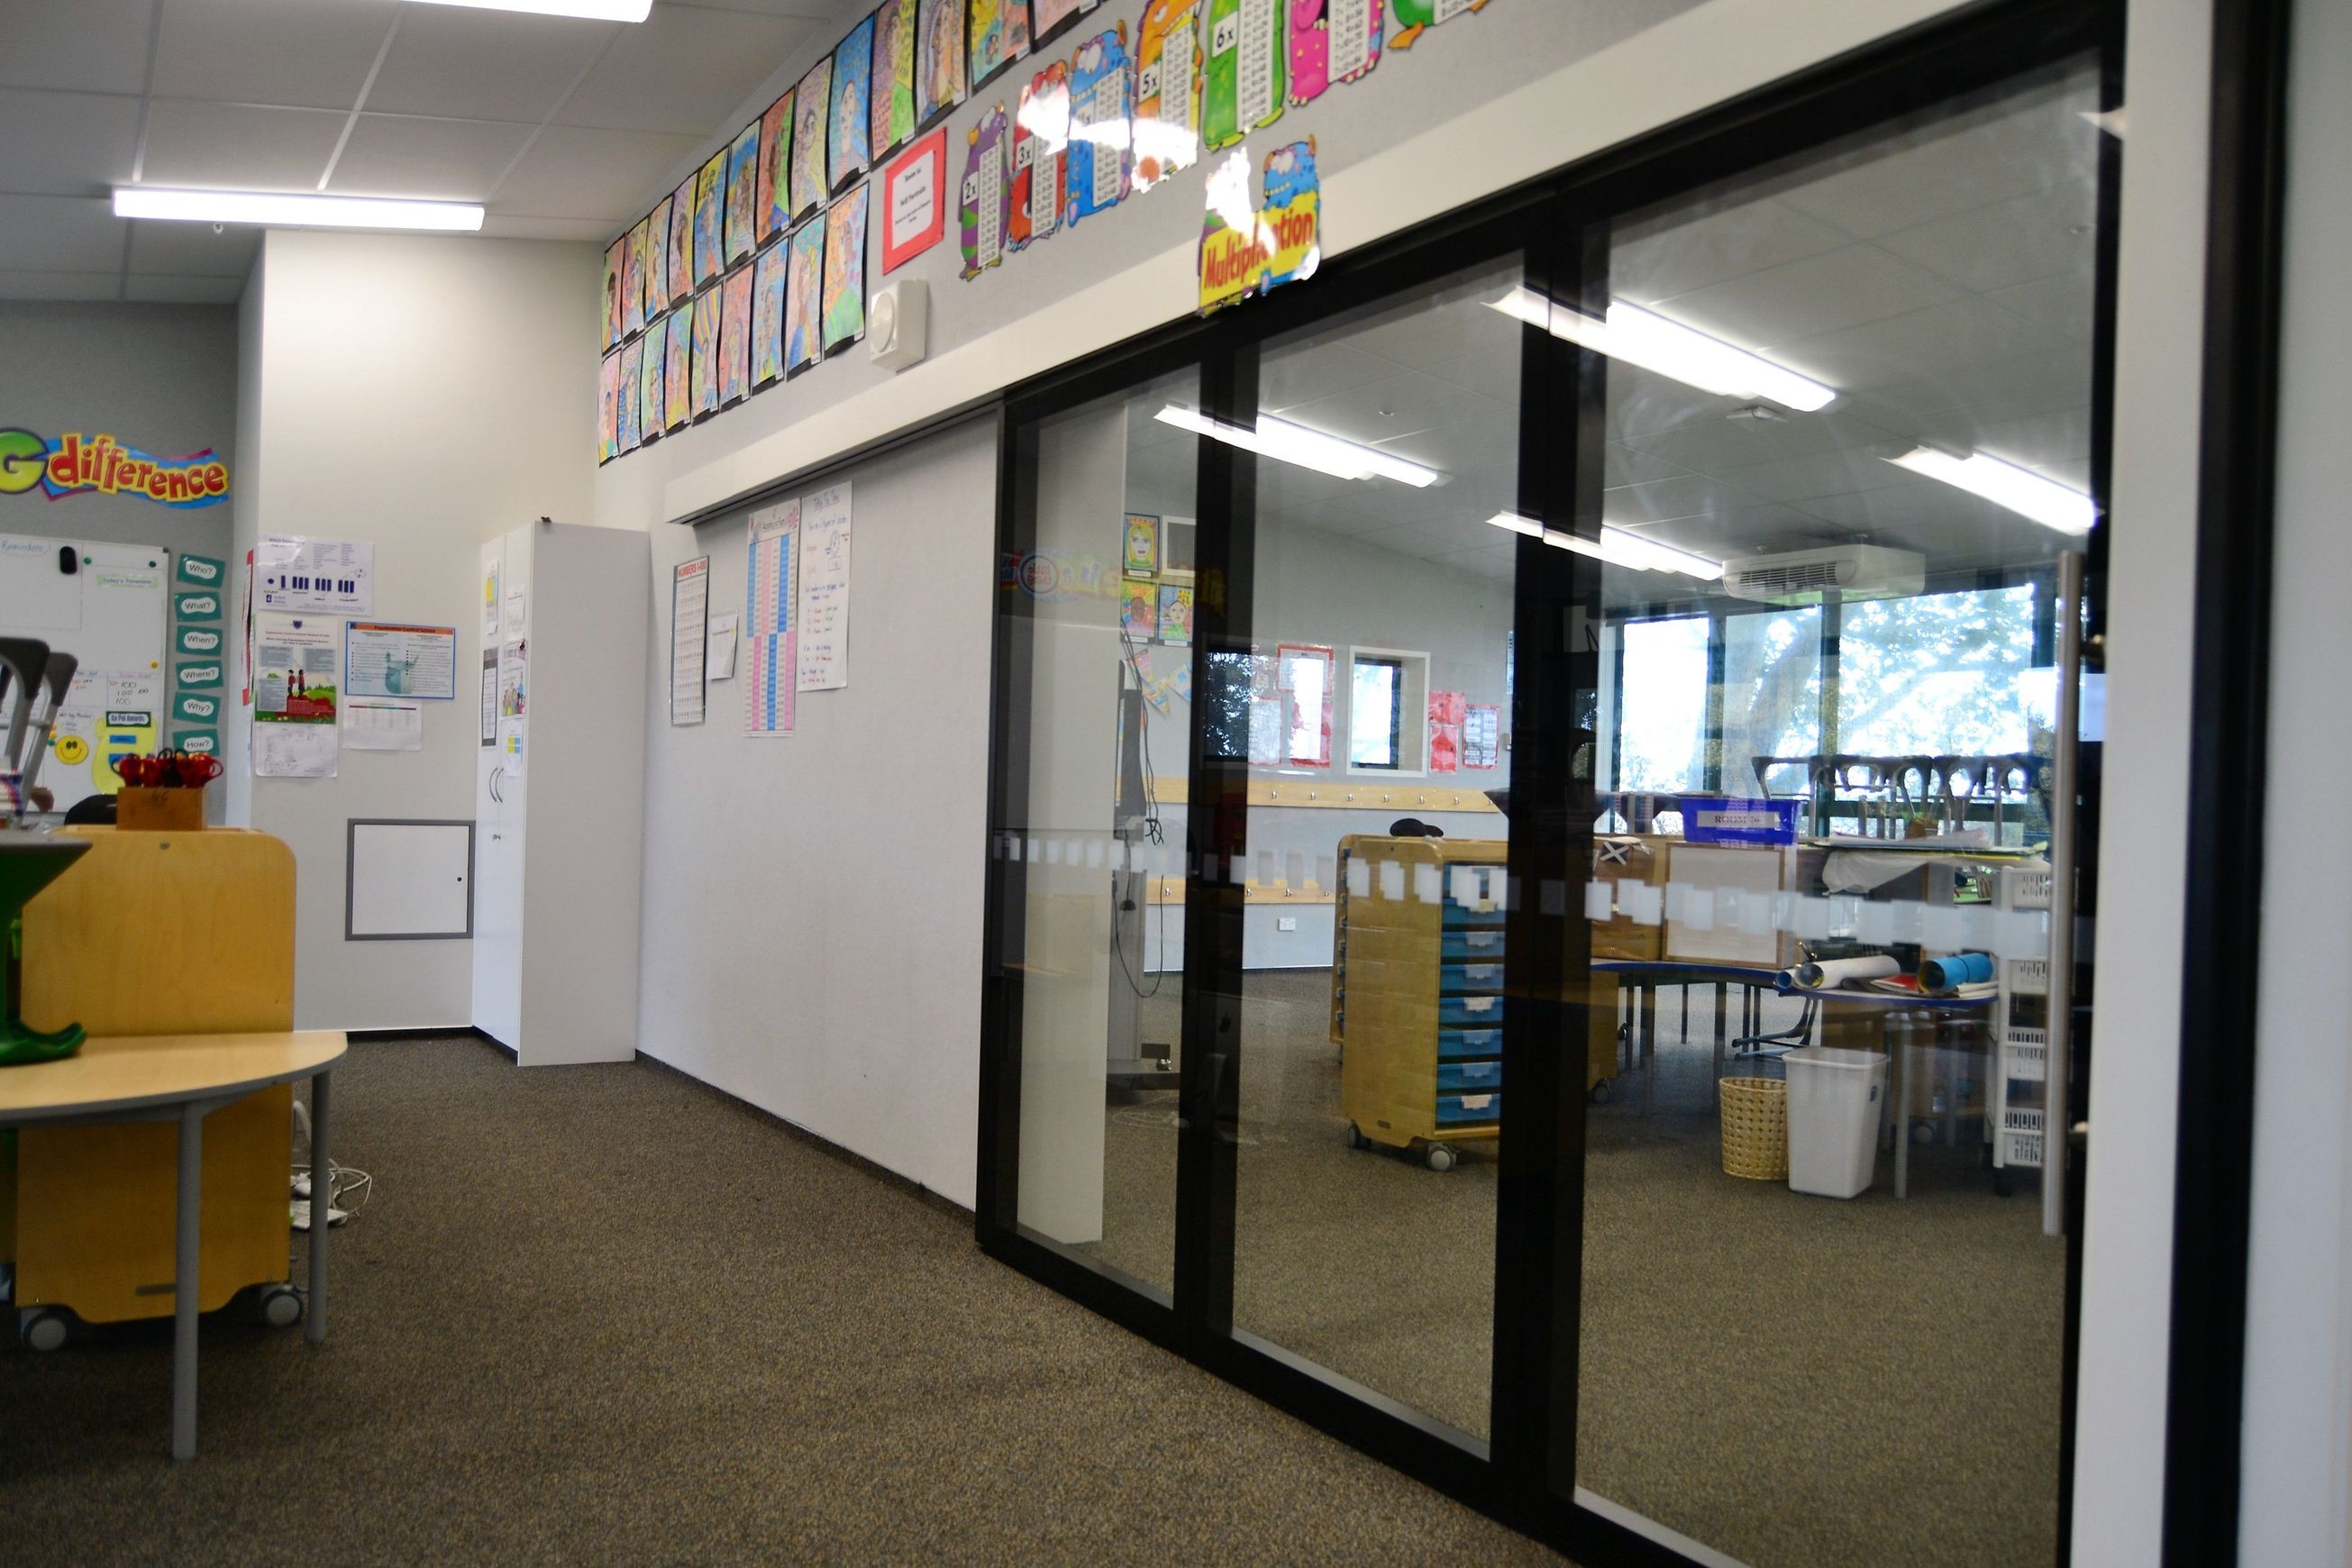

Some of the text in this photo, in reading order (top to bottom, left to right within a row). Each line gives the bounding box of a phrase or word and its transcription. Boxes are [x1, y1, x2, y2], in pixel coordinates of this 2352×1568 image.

[1217, 26, 1234, 49] 6x
[1143, 73, 1158, 95] 5x
[1018, 146, 1031, 164] 3x
[965, 182, 976, 199] 2x
[48, 435, 228, 499] difference
[187, 562, 214, 575] Who?
[185, 601, 211, 610] What?
[187, 634, 215, 644] When?
[184, 670, 215, 679] Where?
[187, 702, 211, 713] Why?
[186, 740, 210, 750] How?
[1715, 815, 1746, 824] ROOM
